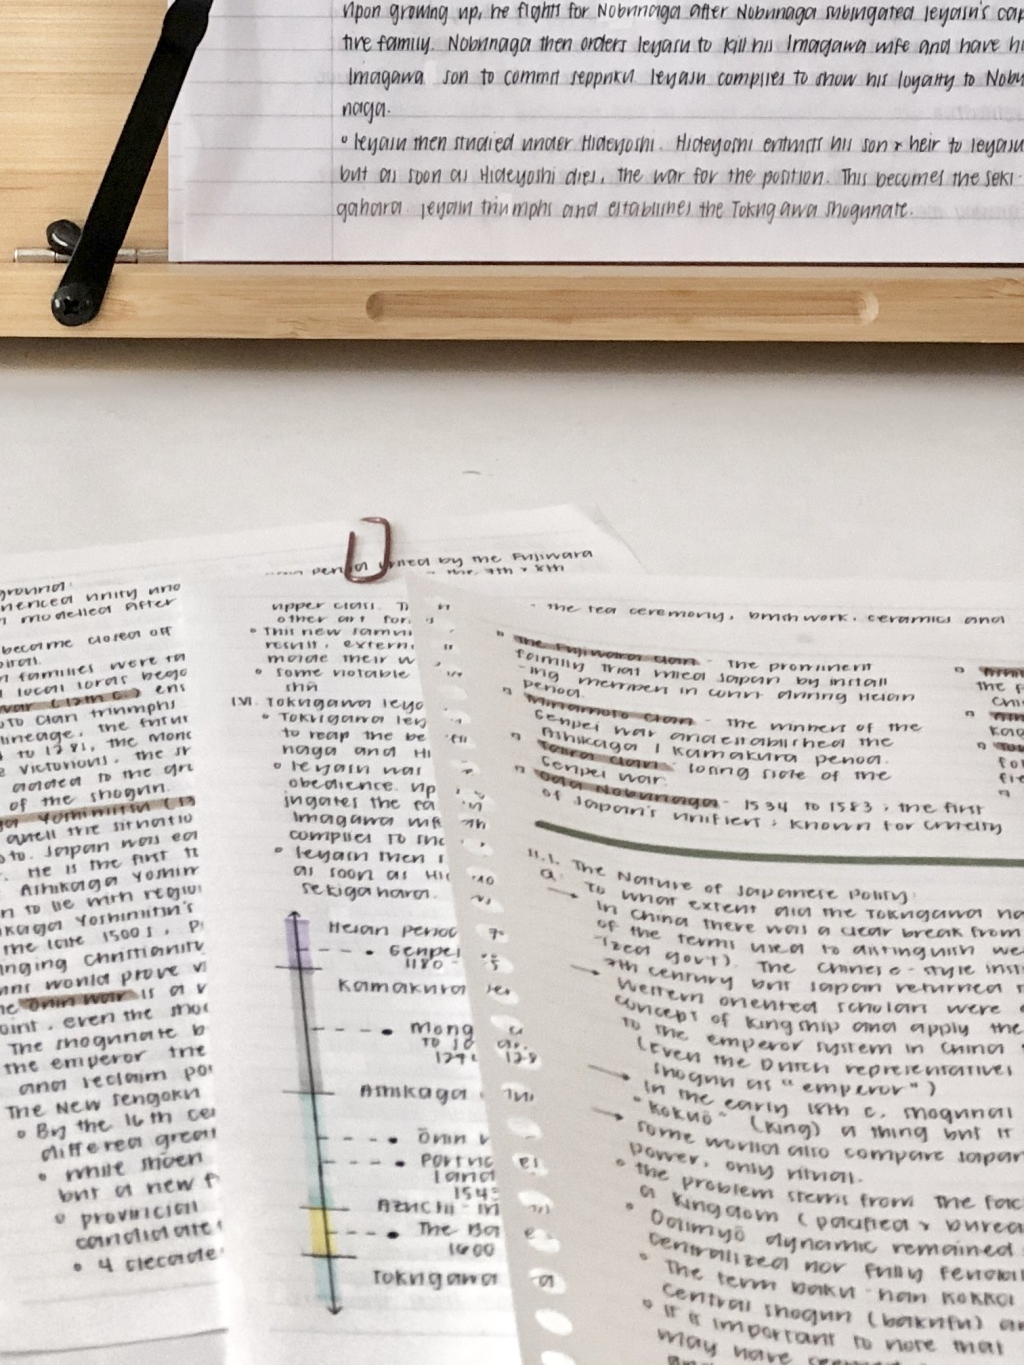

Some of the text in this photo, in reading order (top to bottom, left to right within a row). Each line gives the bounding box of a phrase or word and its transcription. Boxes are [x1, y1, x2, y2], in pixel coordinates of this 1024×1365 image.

[481, 196, 551, 220] triumphs
[562, 202, 598, 219] and
[699, 200, 723, 219] the
[965, 616, 1004, 624] and
[10, 798, 27, 813] of
[42, 795, 74, 807] the
[884, 821, 912, 831] for
[705, 883, 722, 894] of
[339, 979, 466, 995] Kamakura
